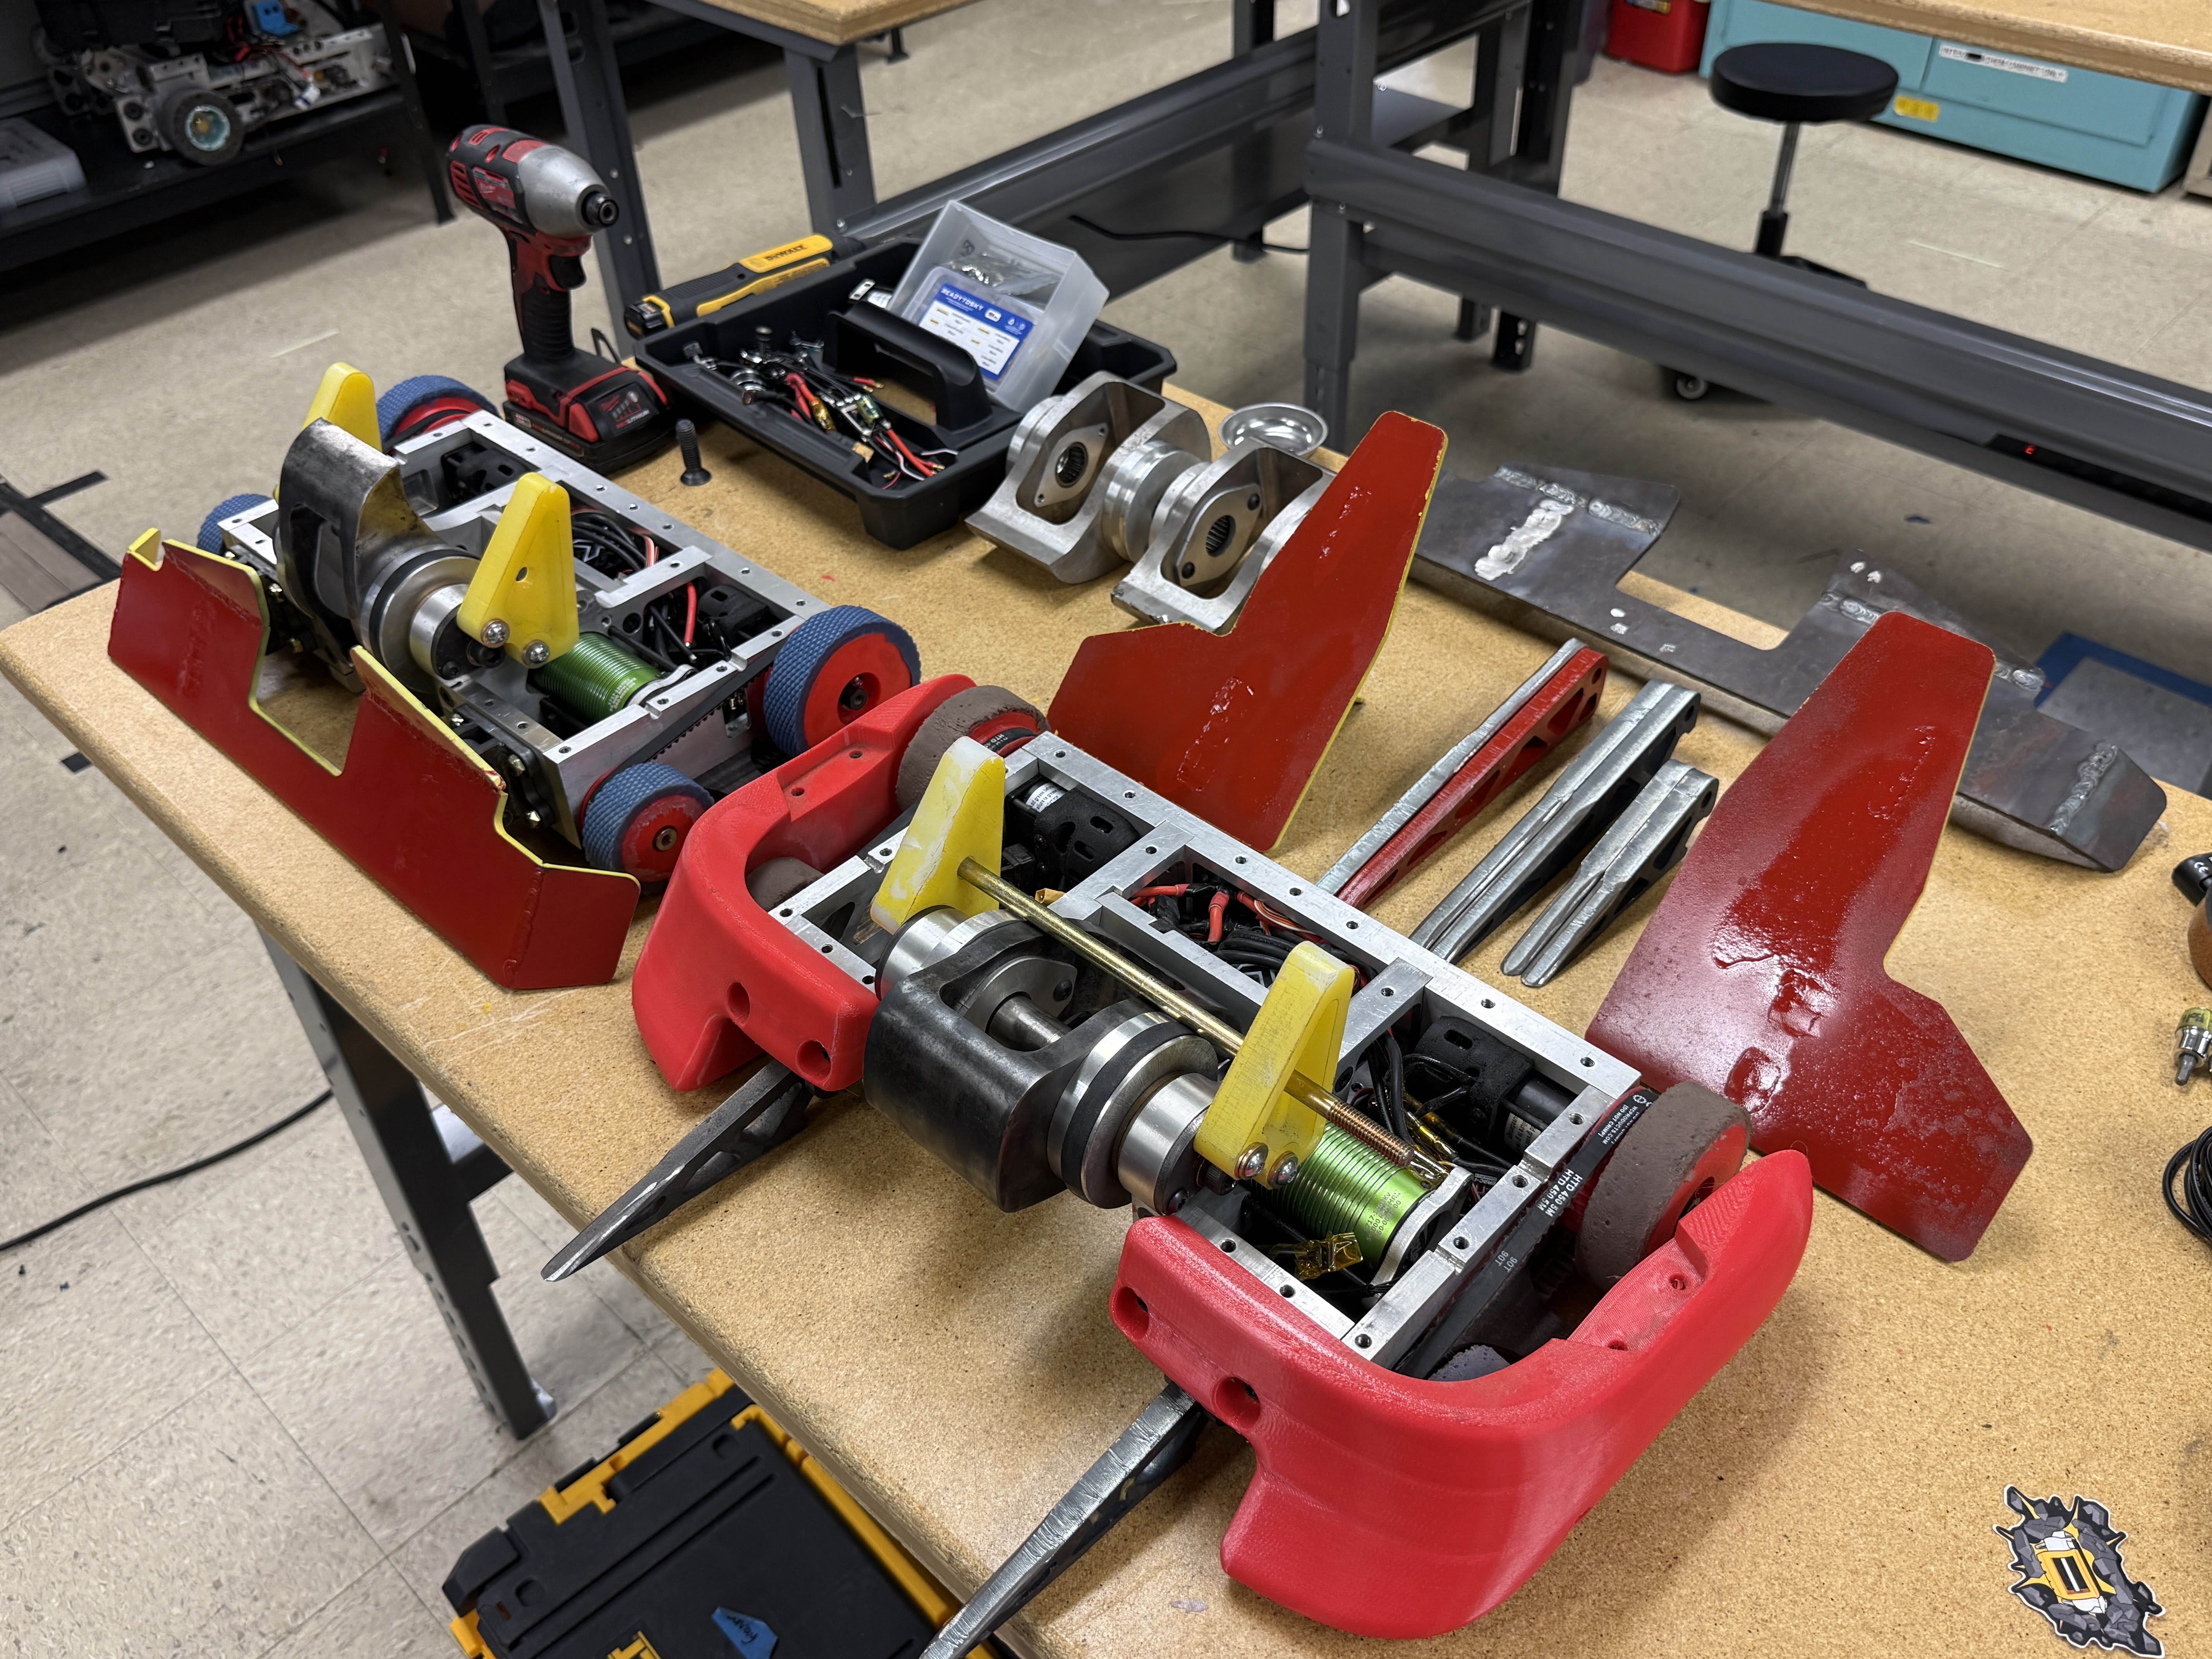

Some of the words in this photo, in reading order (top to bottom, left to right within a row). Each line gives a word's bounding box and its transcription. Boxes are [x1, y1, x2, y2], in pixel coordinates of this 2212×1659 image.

[1612, 1112, 1623, 1121] NOT
[1602, 1106, 1638, 1145] WCPRODUCTS.COM
[1558, 1169, 1574, 1185] HTD
[1566, 1174, 1583, 1192] HTD
[1546, 1185, 1560, 1199] 450
[1555, 1190, 1569, 1205] 450
[1536, 1198, 1549, 1211] 5M
[1545, 1204, 1559, 1217] 5M
[1495, 1250, 1509, 1266] 90T
[1503, 1257, 1518, 1273] 90T
